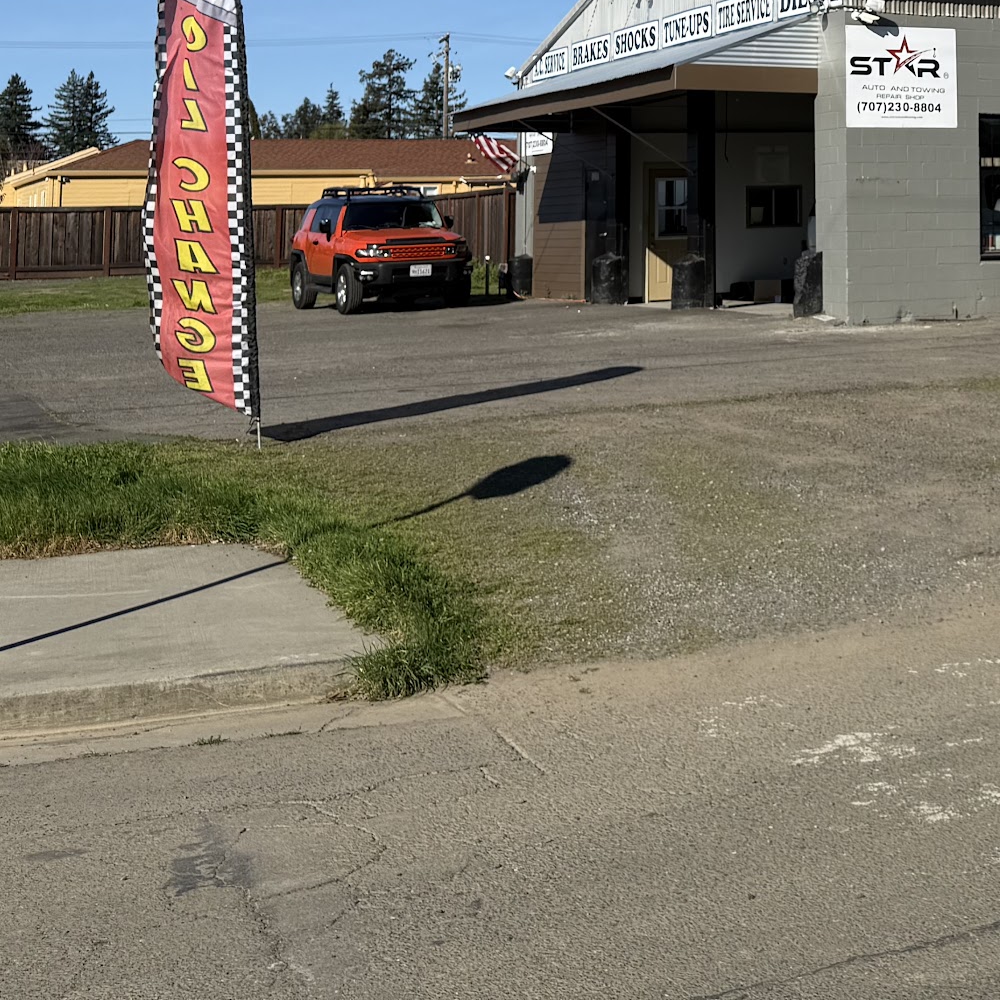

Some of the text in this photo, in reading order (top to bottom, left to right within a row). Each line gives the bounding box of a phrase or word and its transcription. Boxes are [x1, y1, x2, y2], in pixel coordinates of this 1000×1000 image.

[664, 11, 710, 44] TUNE-UPS
[718, 2, 735, 29] TIRE
[572, 39, 609, 66] BRAKES
[615, 26, 656, 55] SHOCKS
[545, 52, 565, 75] SERVICE
[911, 86, 946, 94] TOWING
[857, 101, 941, 114] (707)230-8804
